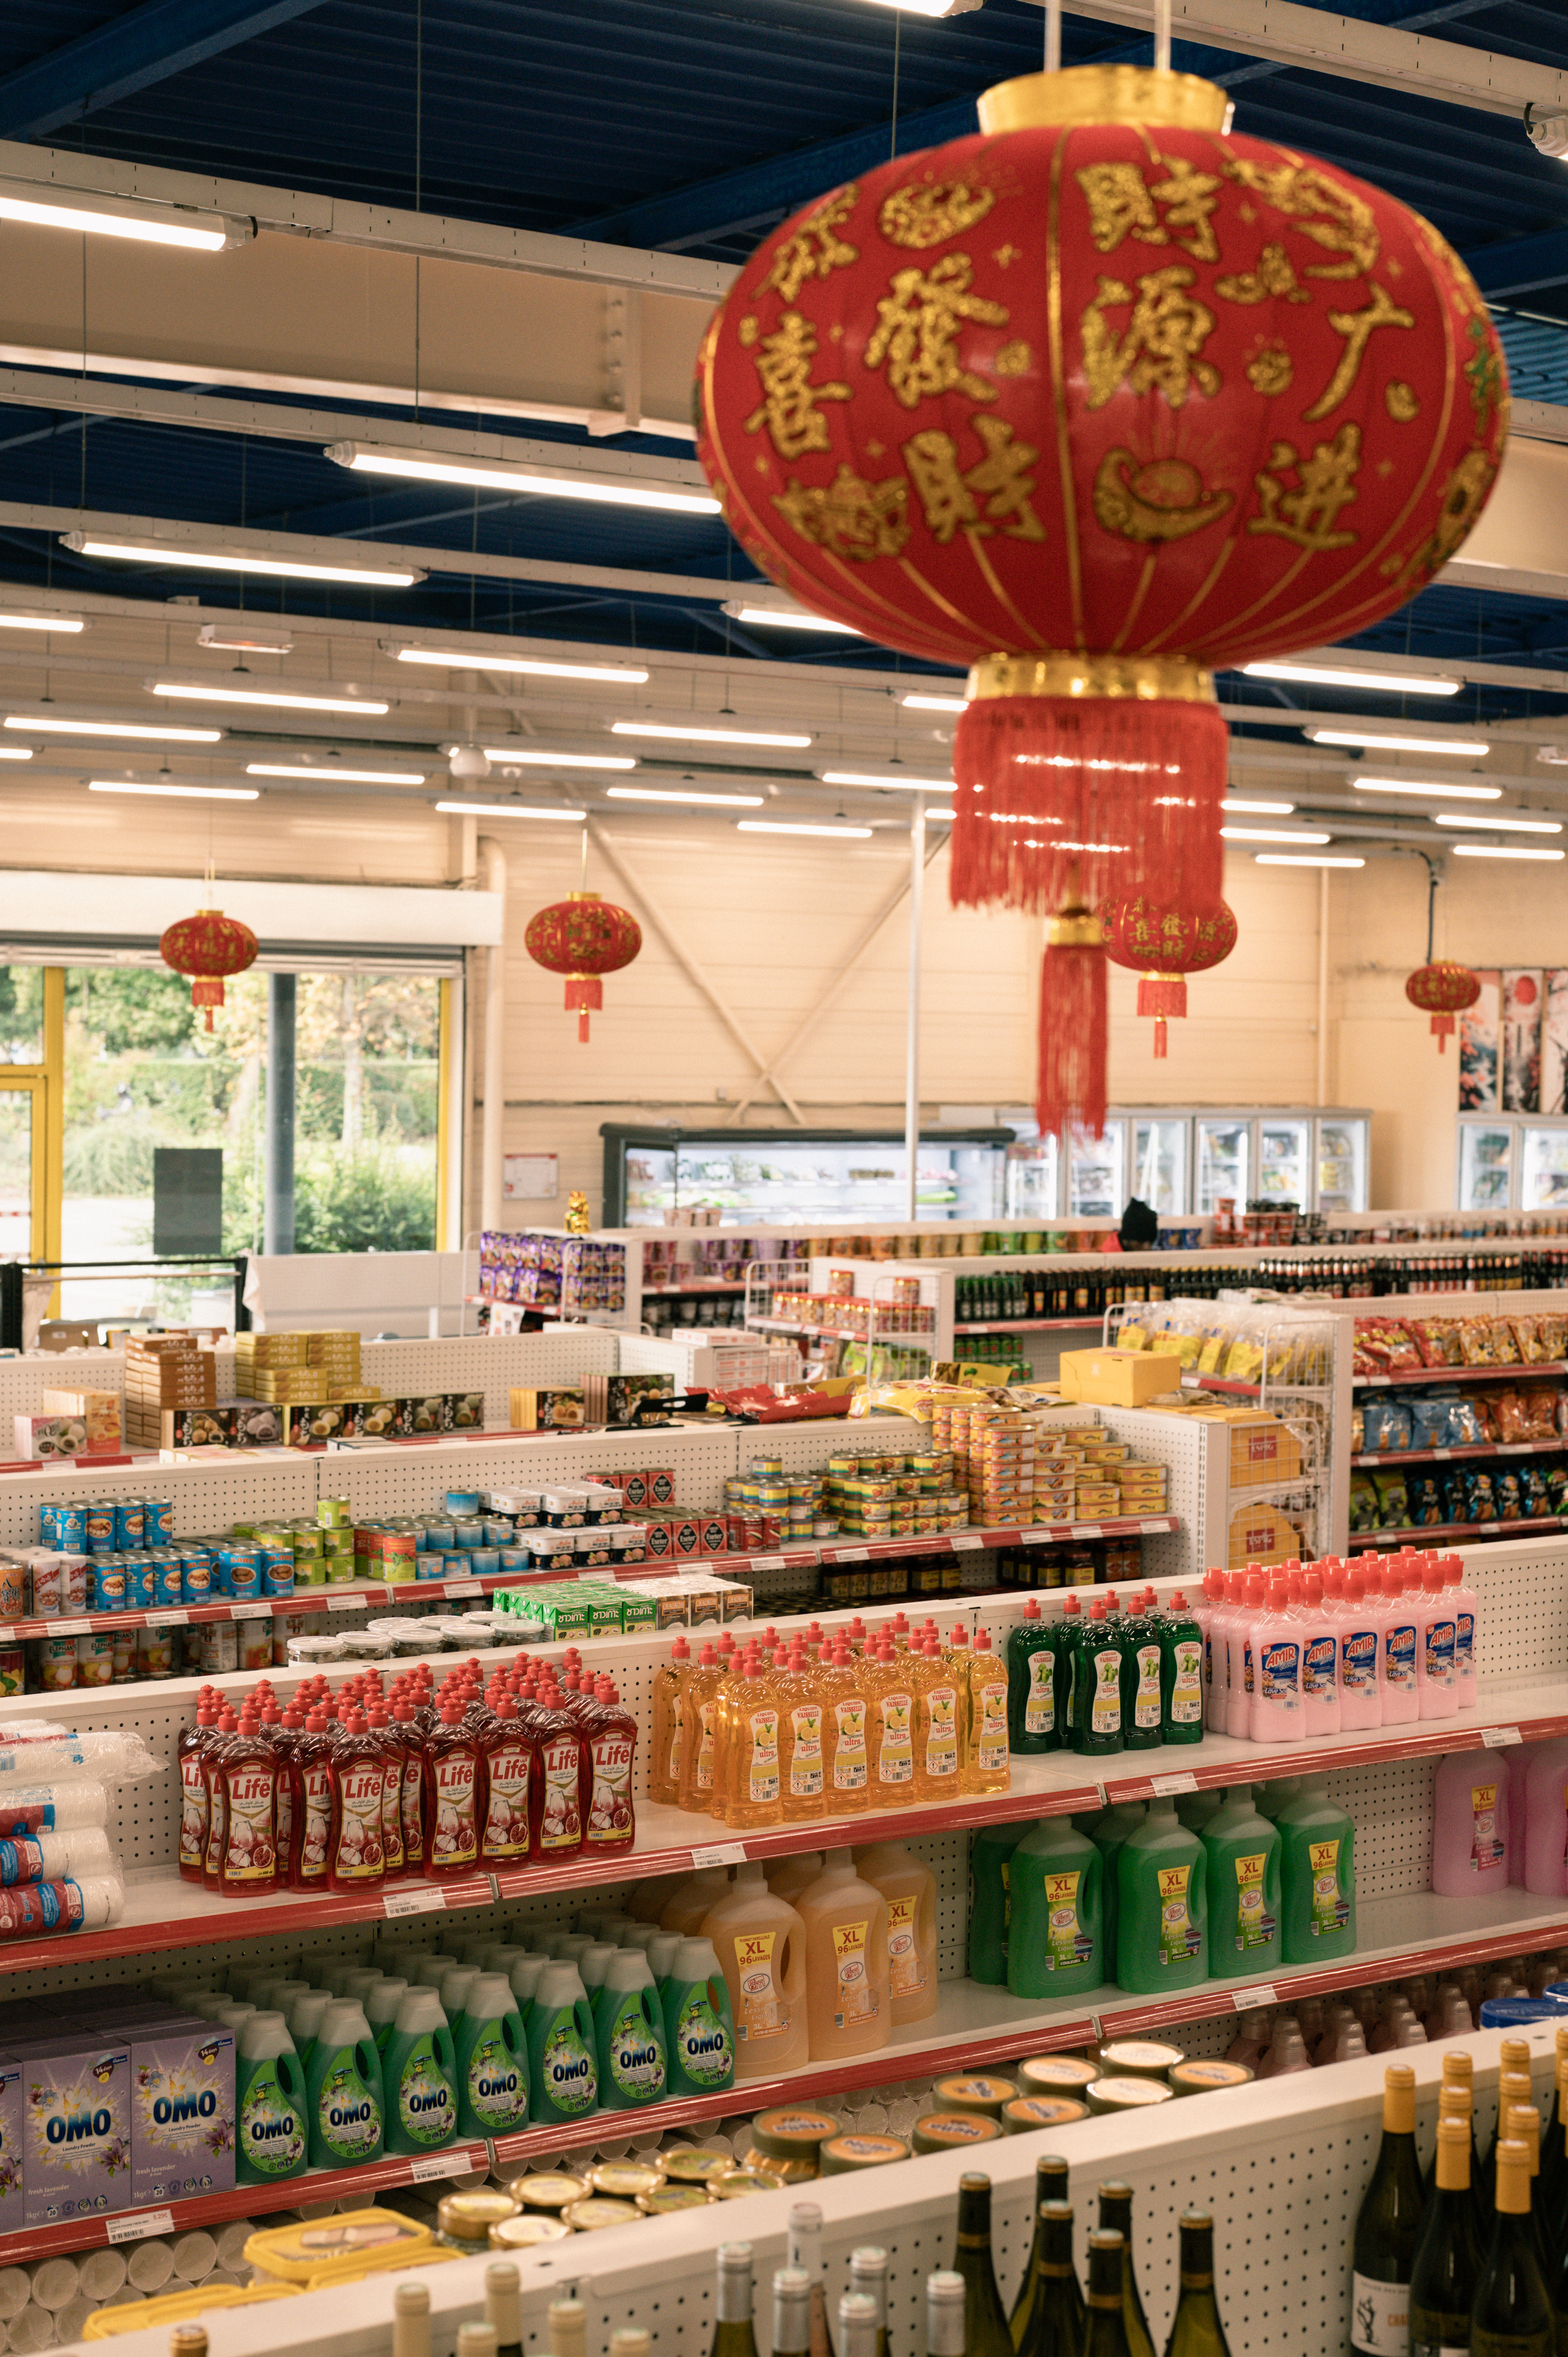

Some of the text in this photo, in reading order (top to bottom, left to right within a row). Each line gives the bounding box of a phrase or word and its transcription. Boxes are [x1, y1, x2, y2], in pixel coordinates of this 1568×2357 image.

[662, 1602, 684, 1610] CHAOKOH
[696, 1598, 717, 1606] CHAOKOH
[728, 1595, 748, 1603] CHAOKOH
[1391, 1630, 1413, 1652] AMIR
[1430, 1625, 1453, 1647] AMIR
[1307, 1641, 1333, 1663] AMIR
[1347, 1636, 1374, 1657] AMIR
[1267, 1647, 1295, 1668] AMIR
[755, 1716, 775, 1724] VAISSELLE
[547, 1749, 577, 1771] Life
[596, 1745, 629, 1765] Life
[439, 1765, 473, 1787] Life
[493, 1759, 528, 1780] Life
[232, 1777, 270, 1800] Life
[345, 1777, 381, 1799] Life
[1318, 1848, 1332, 1860] XL
[1244, 1862, 1259, 1874] XL
[1313, 1861, 1323, 1869] 96
[1167, 1874, 1182, 1886] XL
[1239, 1874, 1249, 1883] 96
[1054, 1880, 1071, 1892] XL
[1162, 1887, 1172, 1895] 96
[1049, 1893, 1060, 1901] 96
[843, 1930, 859, 1944] XL
[1052, 1938, 1075, 1946] Lessive
[745, 1941, 765, 1955] XL
[837, 1945, 848, 1954] 96
[739, 1954, 770, 1965] 96 LAVAGES
[841, 1993, 864, 2002] Lessive
[745, 2005, 771, 2014] Lessive
[752, 2012, 775, 2020] Liquide
[687, 2033, 724, 2055] OMO
[620, 2046, 656, 2068] OMO
[553, 2059, 588, 2082] OMO
[479, 2074, 517, 2097] OMO
[153, 2090, 216, 2124] OMO
[409, 2089, 447, 2113] OMO
[330, 2103, 370, 2126] OMO
[46, 2109, 111, 2144] OMO
[252, 2117, 294, 2140] OMO
[151, 2164, 176, 2173] lavender
[44, 2184, 70, 2192] lavender
